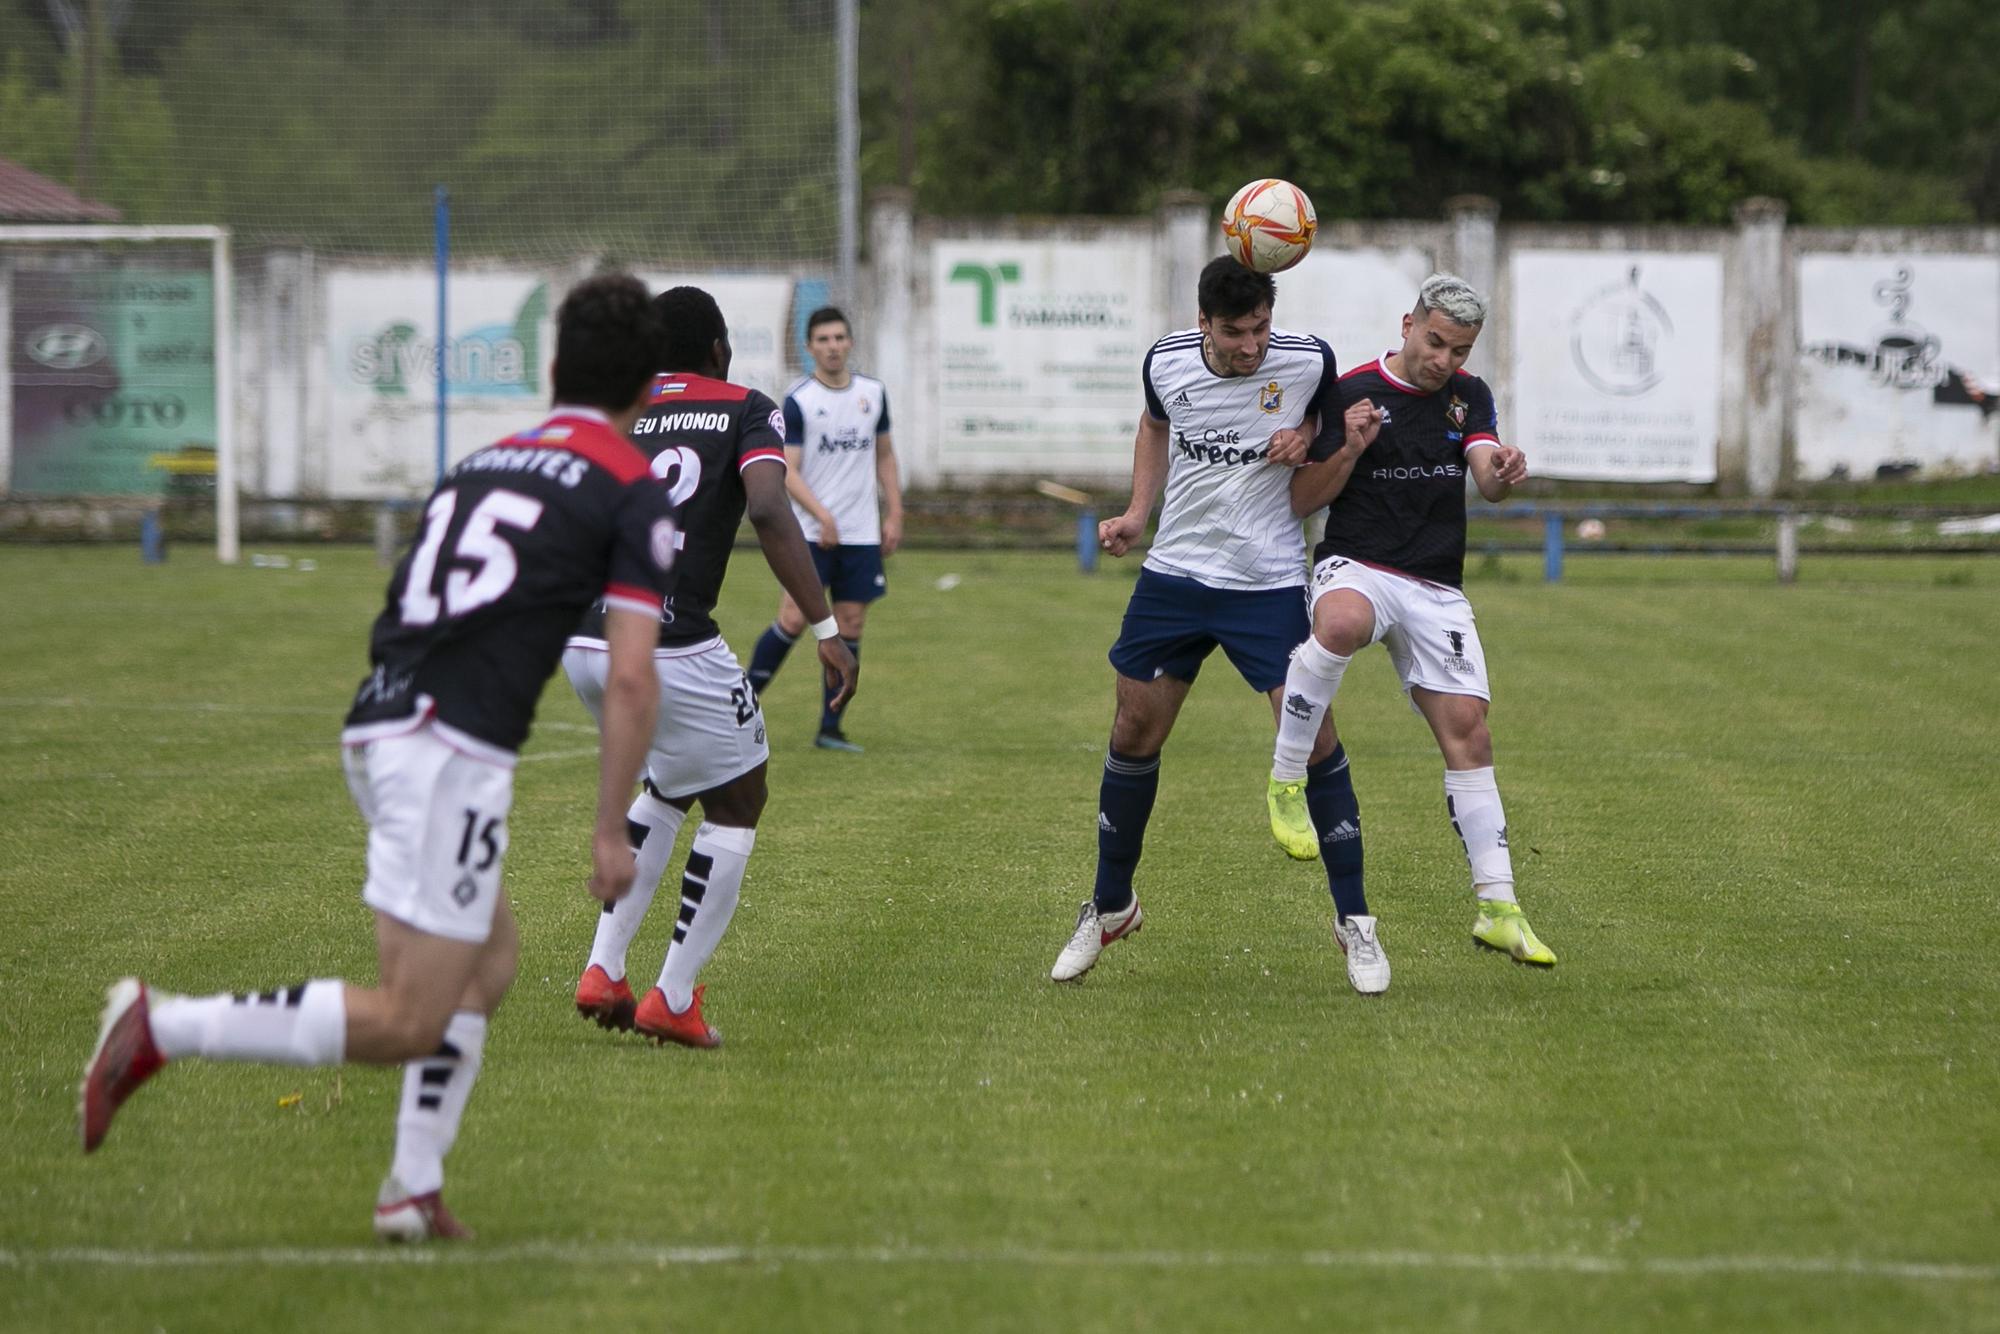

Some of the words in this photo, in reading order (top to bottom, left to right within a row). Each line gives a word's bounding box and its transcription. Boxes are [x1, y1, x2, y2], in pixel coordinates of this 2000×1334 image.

[659, 412, 730, 434] MVONDO
[1203, 429, 1240, 444] Café
[1176, 431, 1269, 466] Arece
[401, 488, 543, 625] 15
[457, 807, 503, 872] 15
